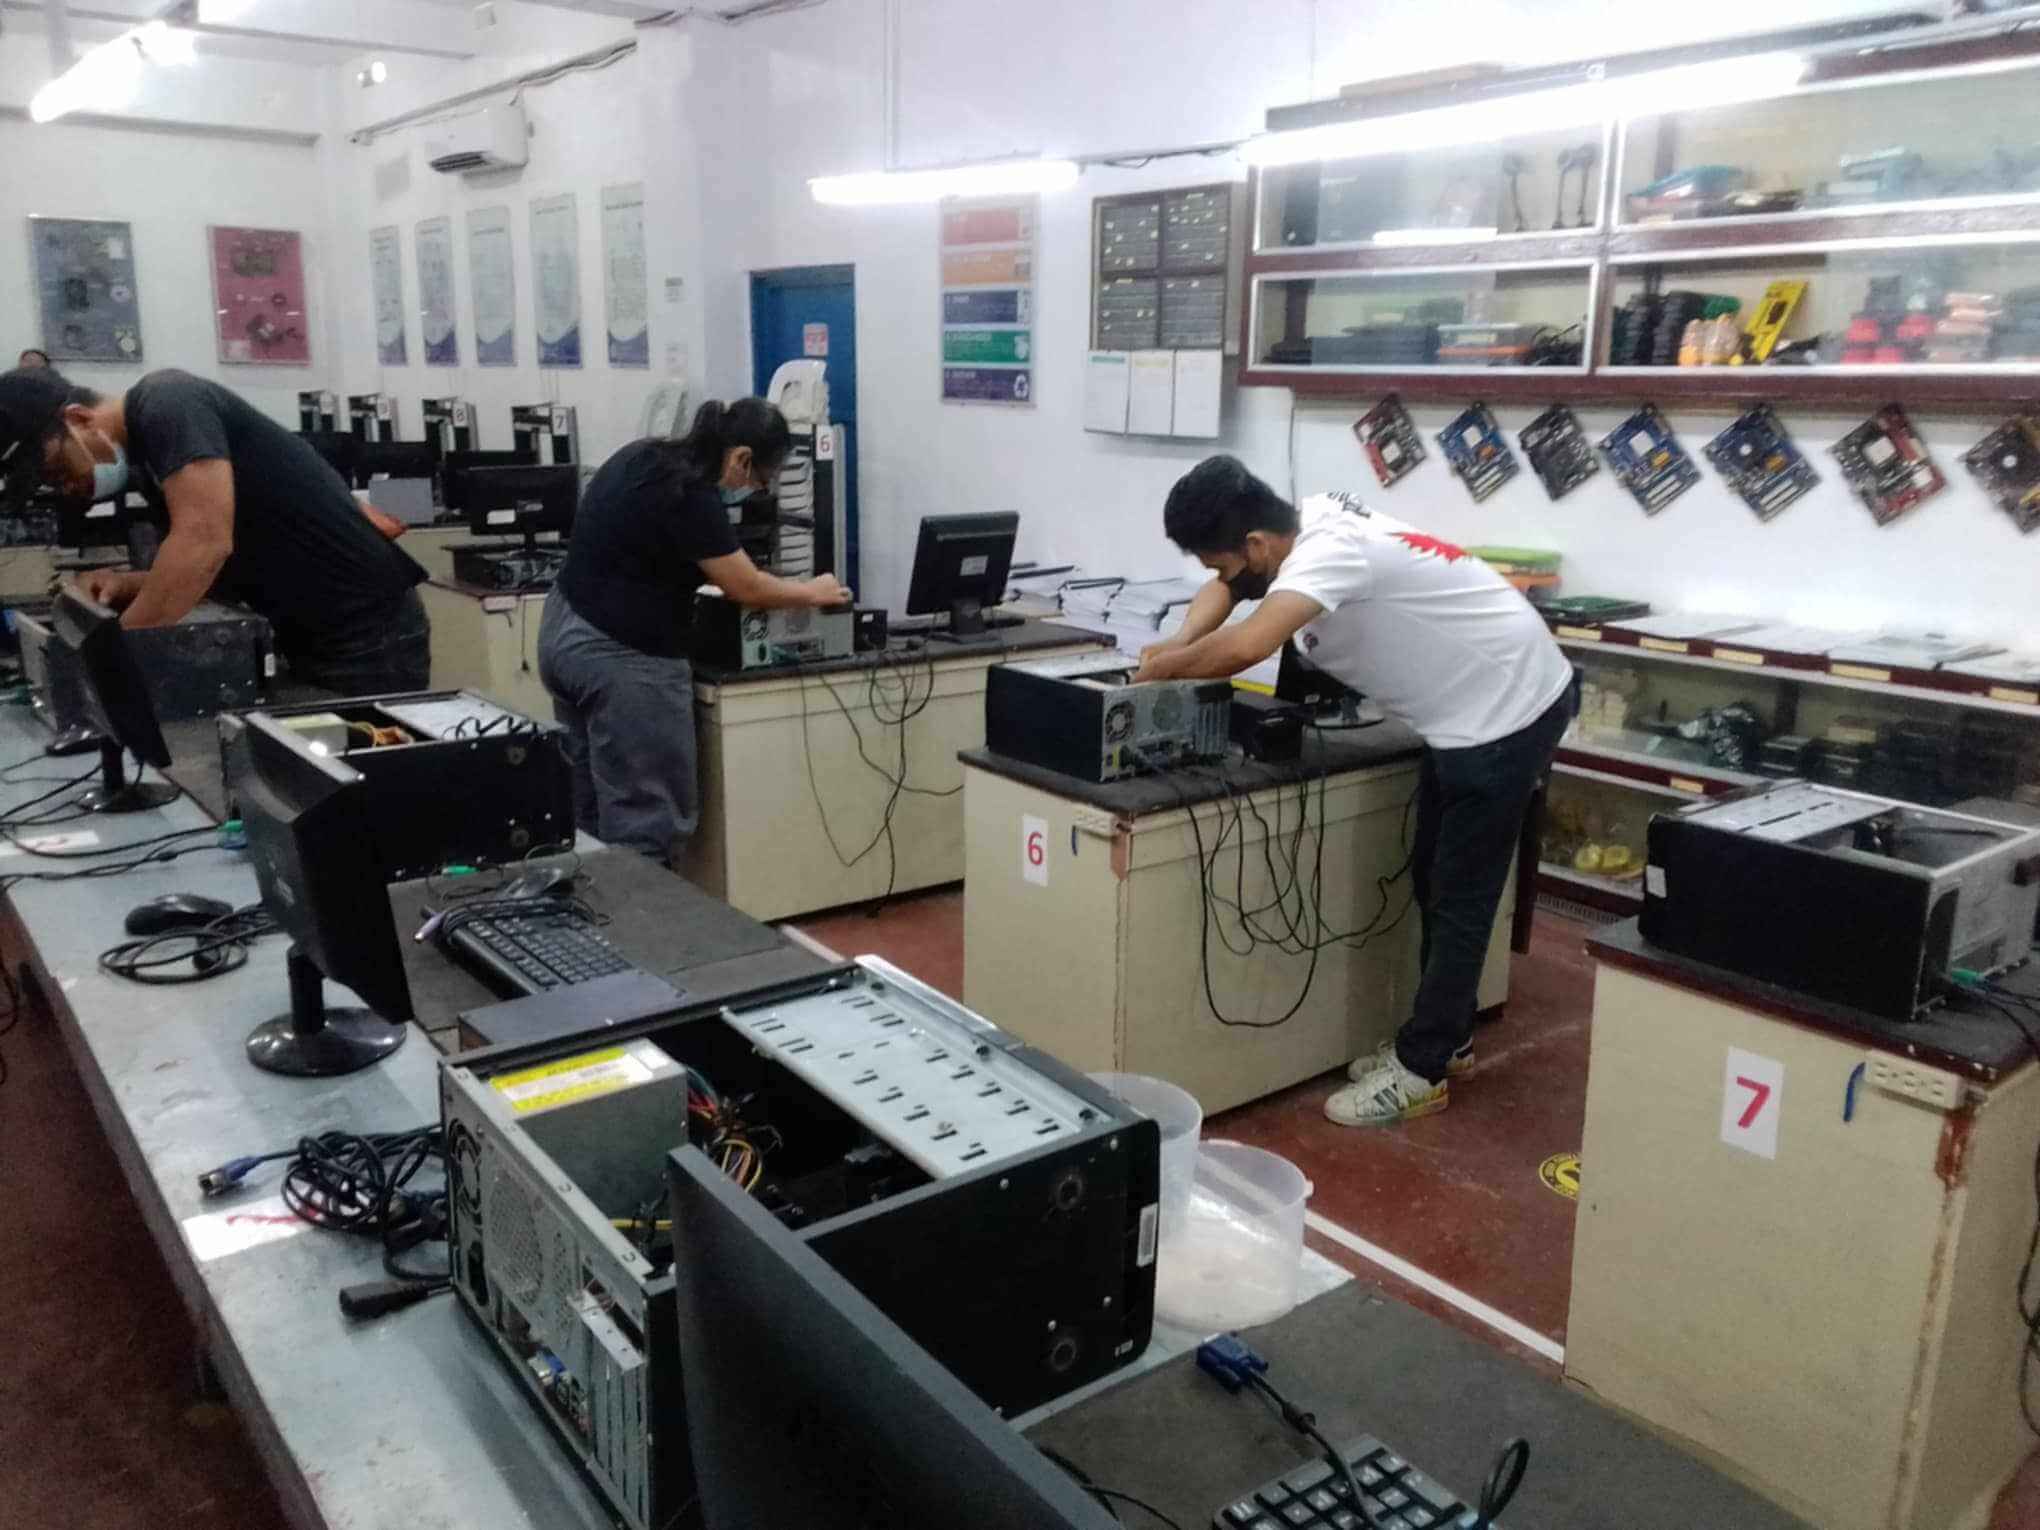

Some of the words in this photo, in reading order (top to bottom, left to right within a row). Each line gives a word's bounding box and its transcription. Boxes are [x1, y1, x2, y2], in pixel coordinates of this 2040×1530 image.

[555, 415, 564, 430] 7
[820, 434, 830, 452] 6
[1028, 831, 1043, 866] 6
[1736, 1076, 1770, 1129] 7
